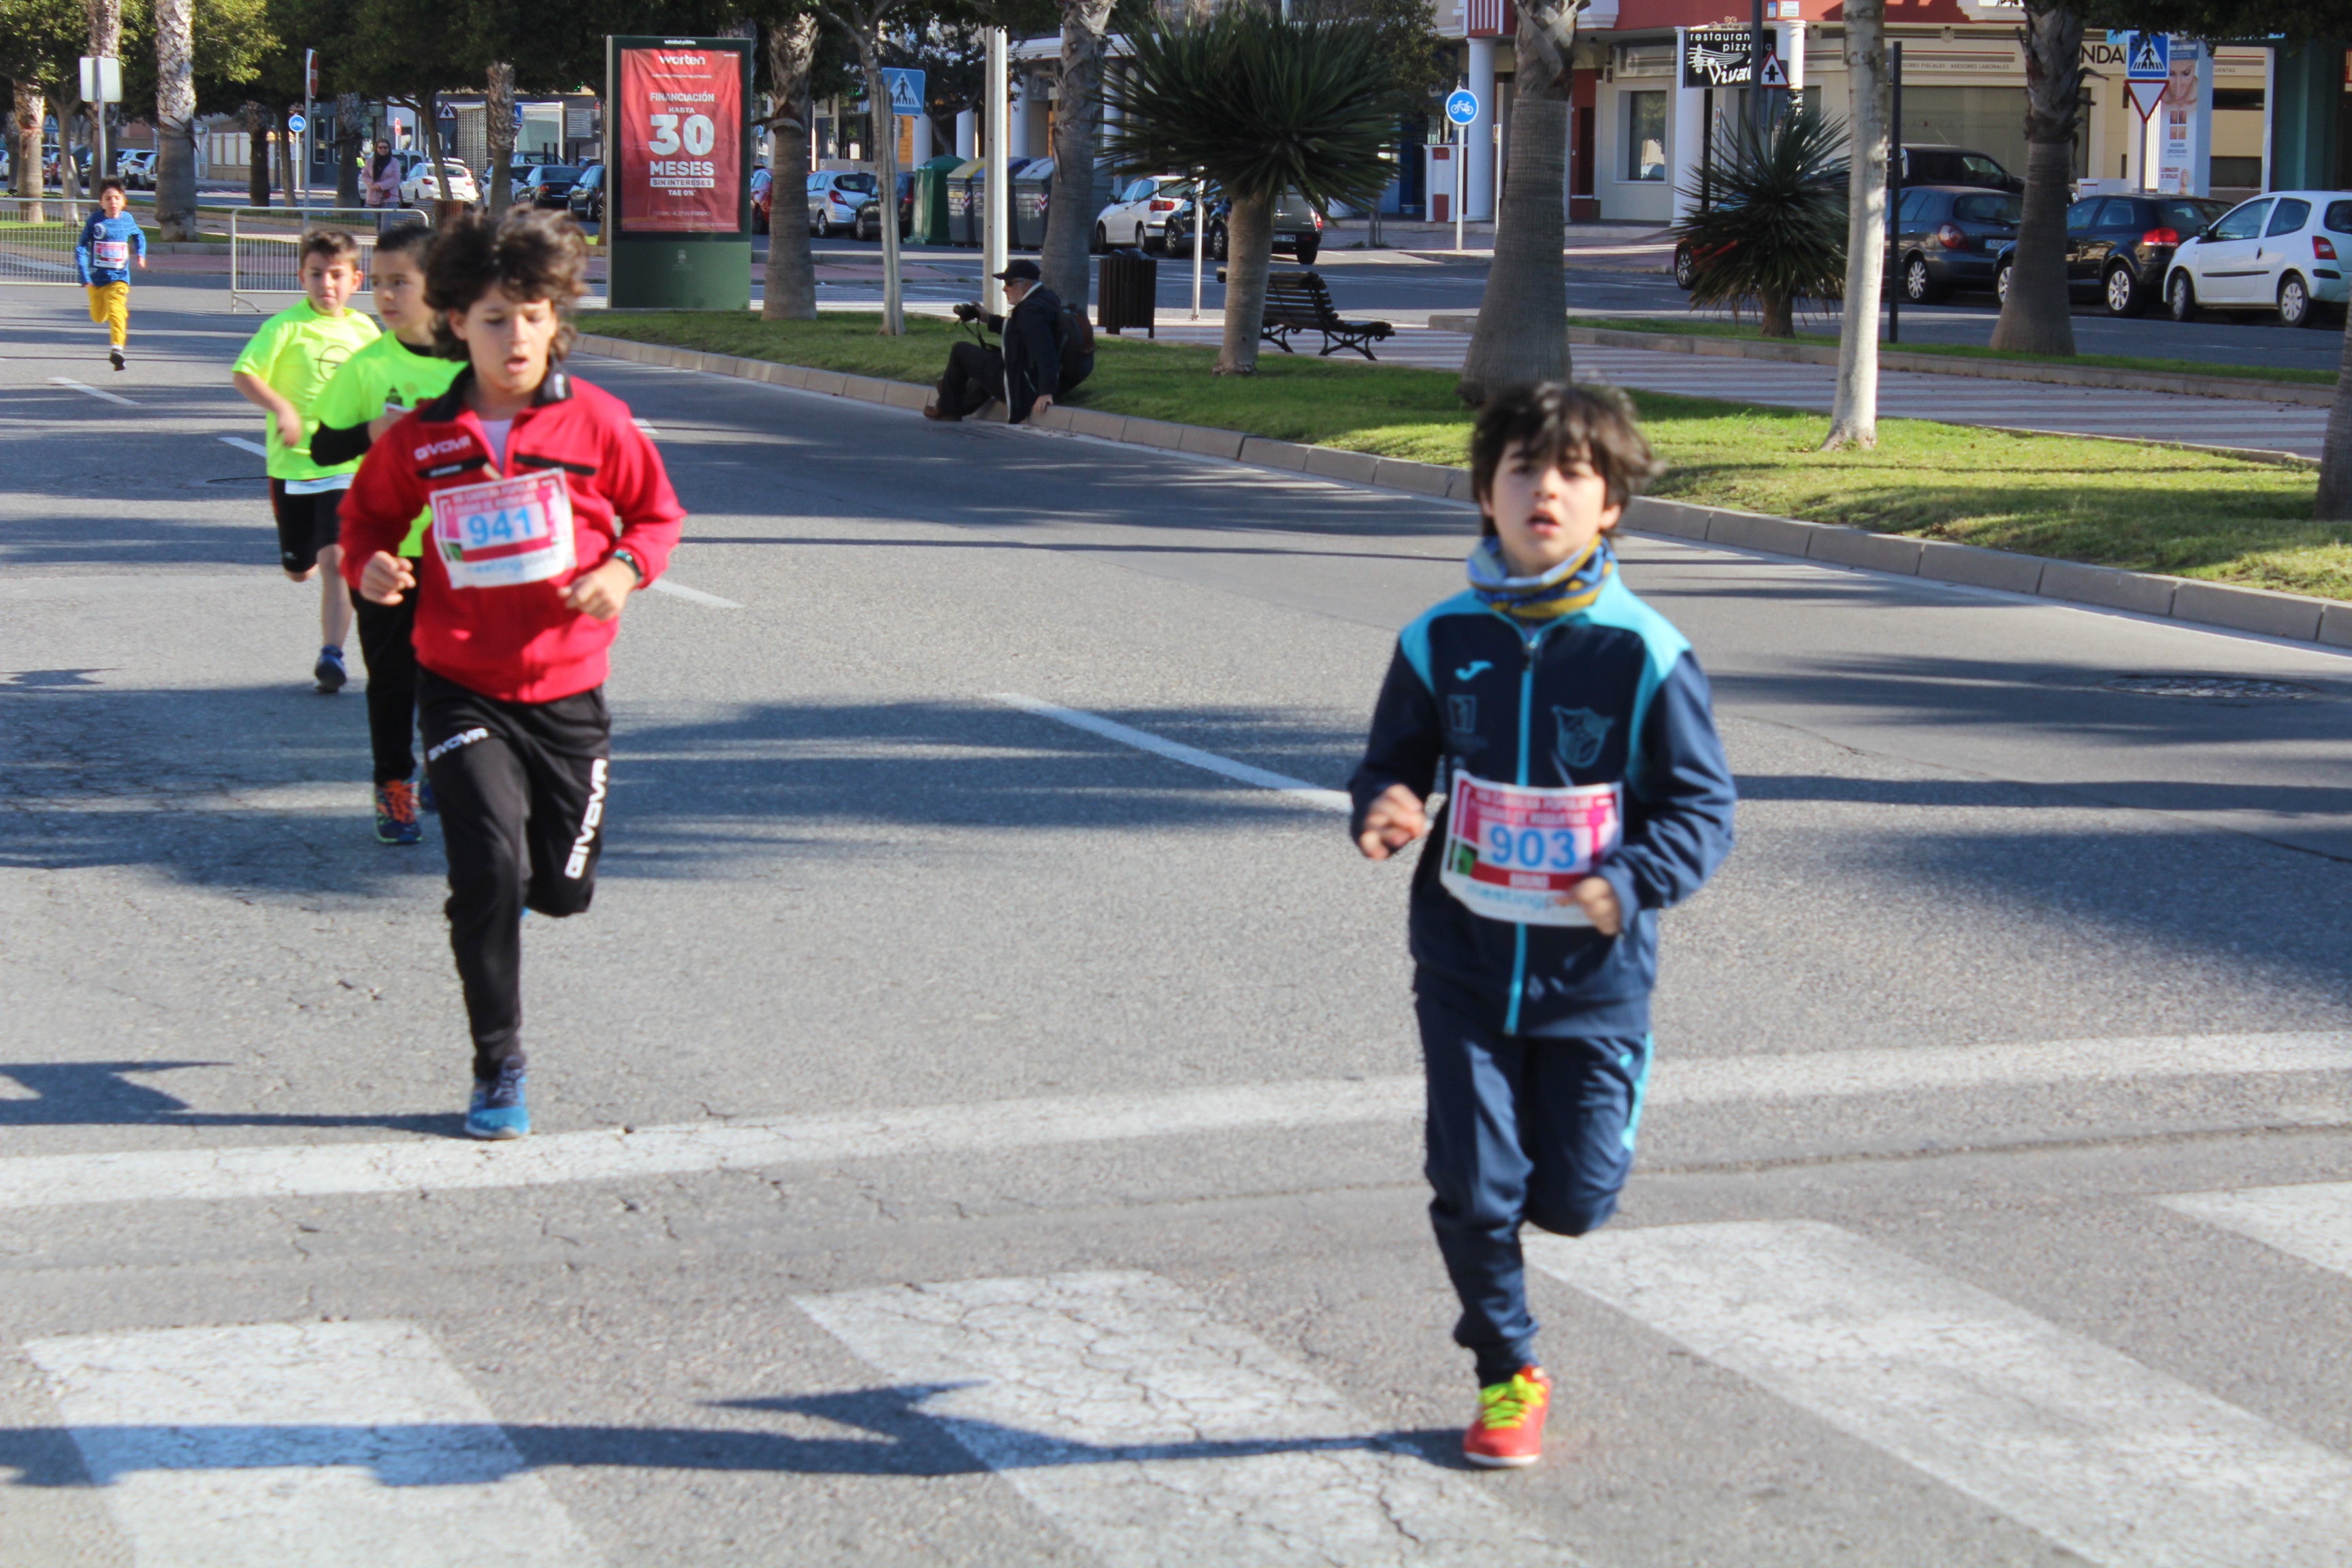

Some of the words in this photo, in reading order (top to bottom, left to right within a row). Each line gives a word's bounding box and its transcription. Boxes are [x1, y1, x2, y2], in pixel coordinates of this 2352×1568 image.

[1690, 32, 1750, 41] restauran
[649, 91, 715, 102] FINANCIACIÓN
[649, 114, 715, 156] 30
[649, 161, 715, 176] MESES
[467, 506, 532, 545] 941
[1490, 825, 1577, 870] 903
